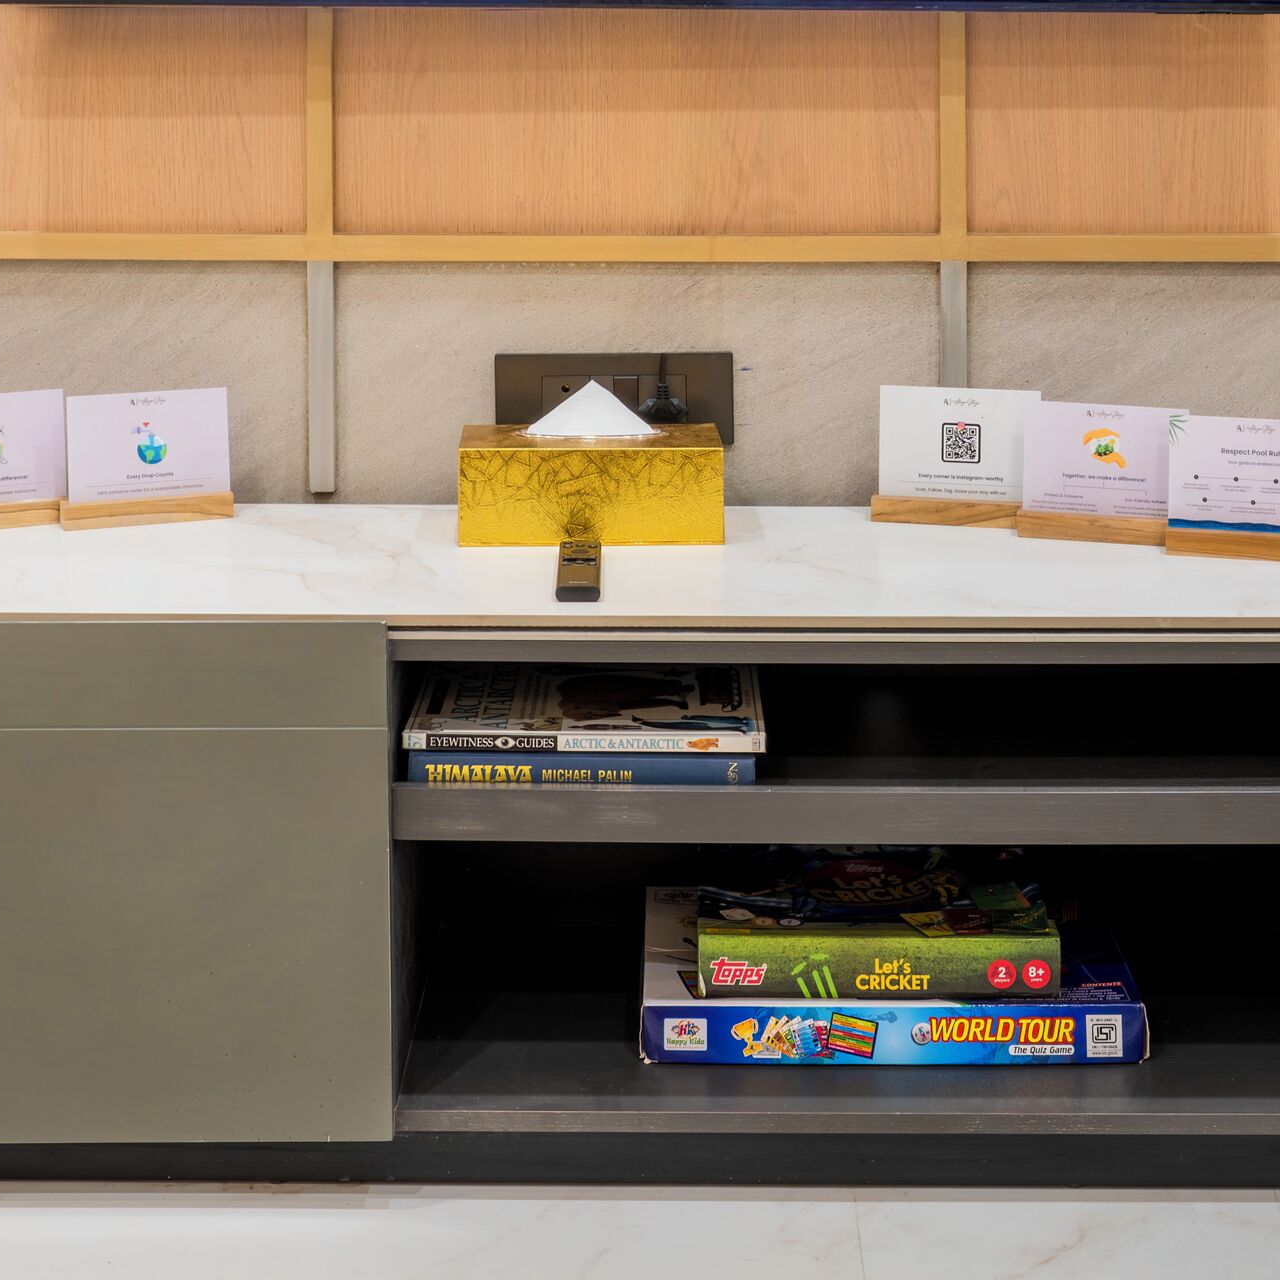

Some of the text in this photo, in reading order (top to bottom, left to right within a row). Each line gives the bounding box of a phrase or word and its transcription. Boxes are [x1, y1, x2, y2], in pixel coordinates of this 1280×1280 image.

[1220, 447, 1250, 456] Respect
[1251, 449, 1268, 457] Pool
[0, 473, 29, 482] difference!
[918, 472, 933, 480] Every
[429, 736, 555, 749] EYEWITNESS GUIDES
[564, 738, 684, 750] ARCTIC & ANTARCTIC
[541, 769, 594, 783] MICHAEL
[598, 769, 633, 783] PALIN
[874, 958, 911, 974] Let's
[998, 966, 1007, 978] 2
[1028, 965, 1045, 978] 8+
[855, 974, 931, 991] CRICKET
[929, 1017, 1075, 1044] WORLD TOUR
[666, 1038, 688, 1046] Happy
[1013, 1046, 1073, 1055] The Quiz Game
